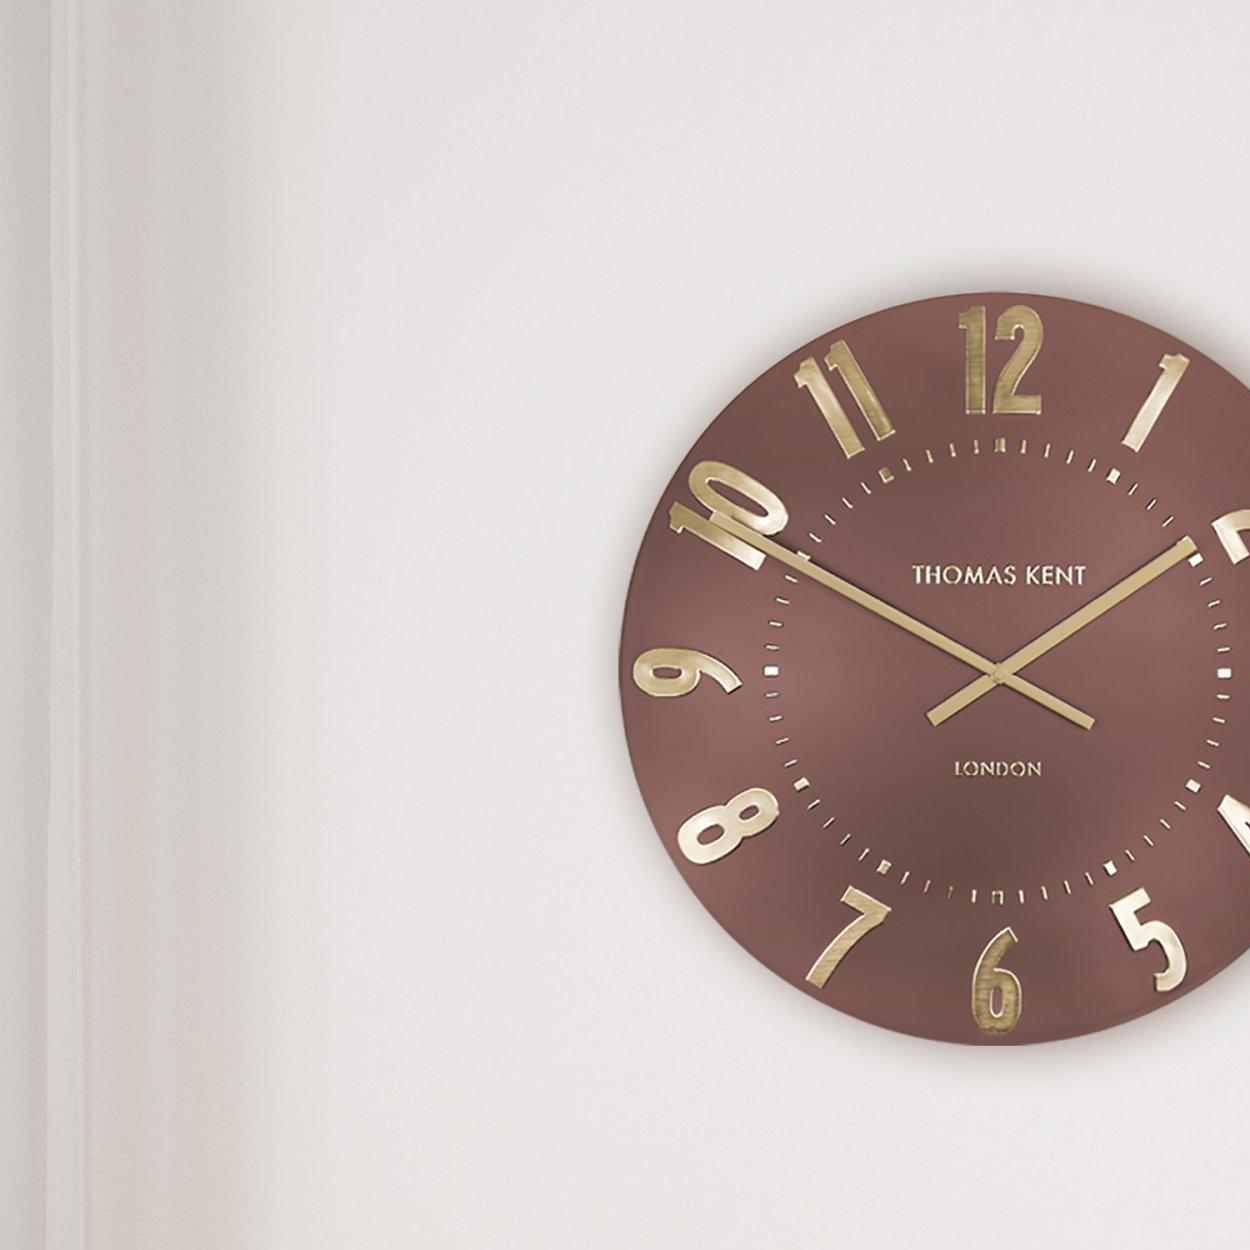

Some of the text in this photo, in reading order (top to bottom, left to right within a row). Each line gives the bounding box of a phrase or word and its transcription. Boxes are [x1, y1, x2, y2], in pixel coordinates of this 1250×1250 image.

[793, 339, 895, 459] 11
[958, 305, 1044, 415] 12
[1121, 353, 1190, 453] 1
[668, 460, 789, 570] 10
[912, 565, 1086, 585] THOMAS KENT
[633, 647, 743, 697] 9
[954, 761, 1042, 777] LONDON
[677, 787, 779, 865] 8
[806, 885, 892, 988] 7
[971, 927, 1022, 1035] 6
[1109, 887, 1188, 992] 5
